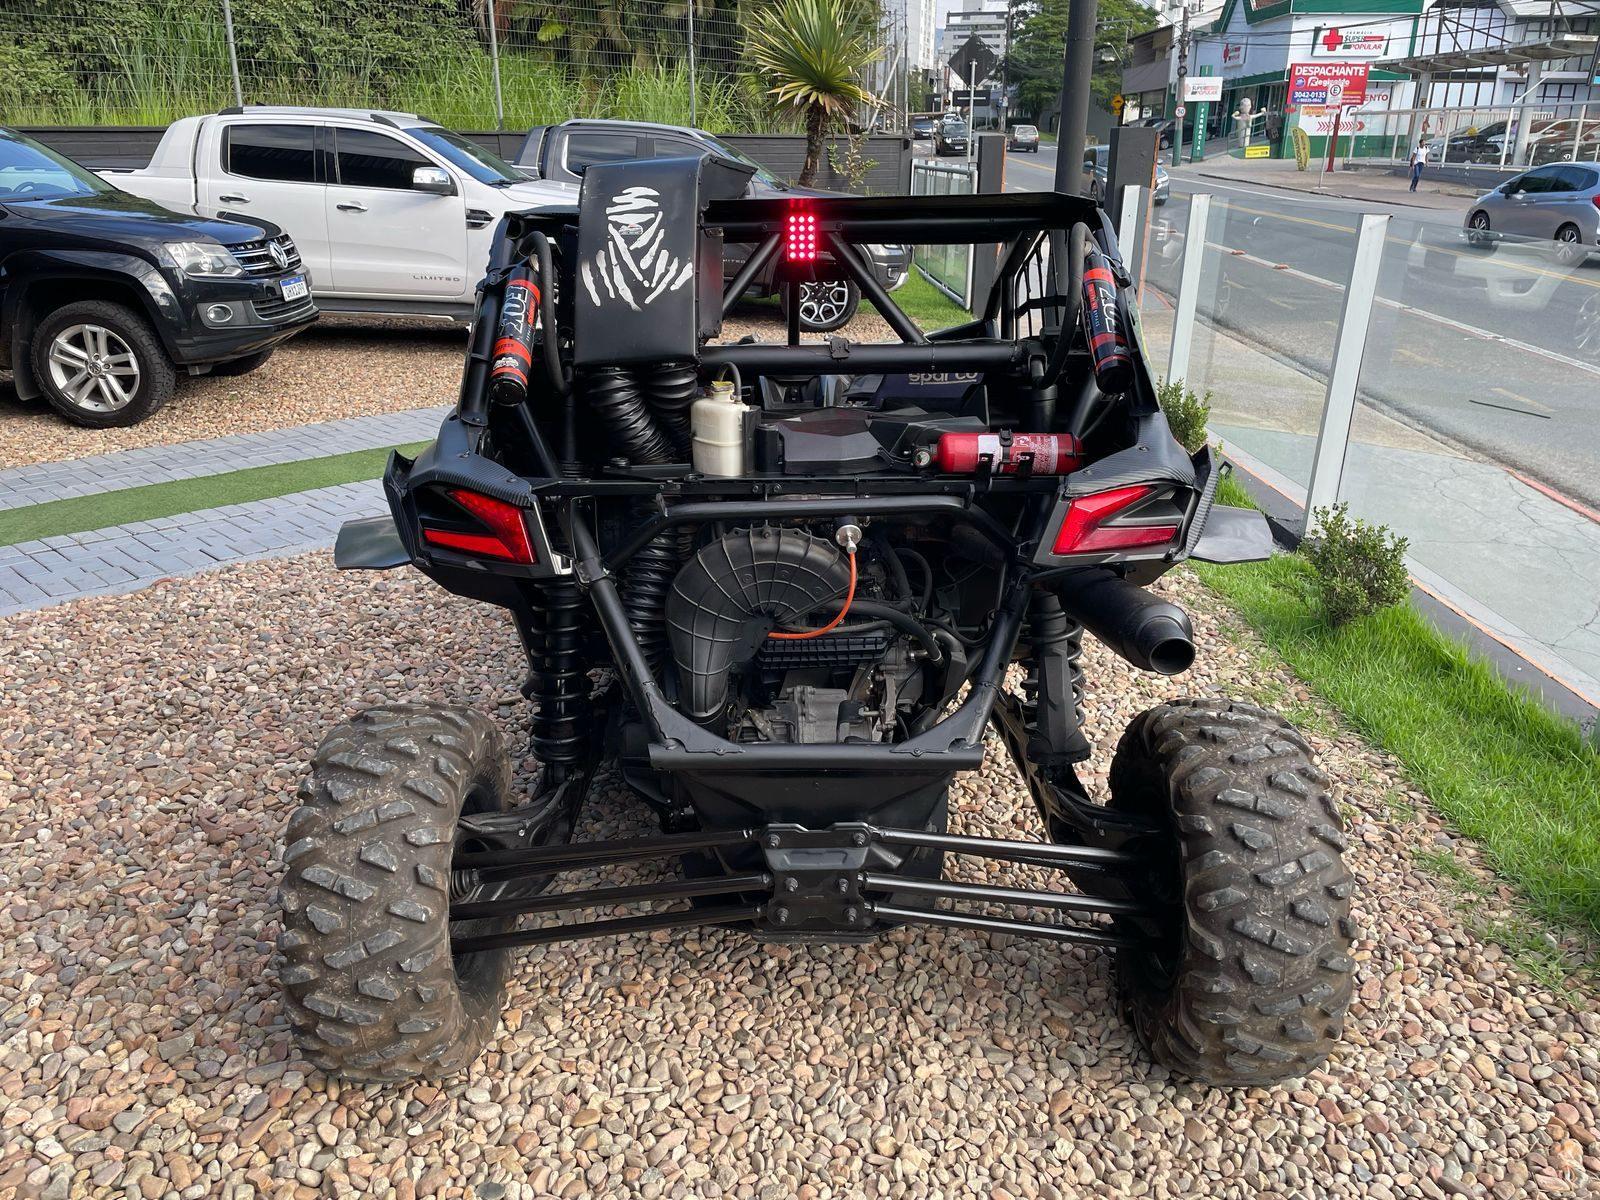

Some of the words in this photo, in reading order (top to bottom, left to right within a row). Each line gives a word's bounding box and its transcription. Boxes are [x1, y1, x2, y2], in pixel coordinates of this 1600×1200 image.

[1294, 66, 1366, 76] DESPACHANTE
[1364, 94, 1389, 102] ENTO
[502, 286, 528, 334] FOX
